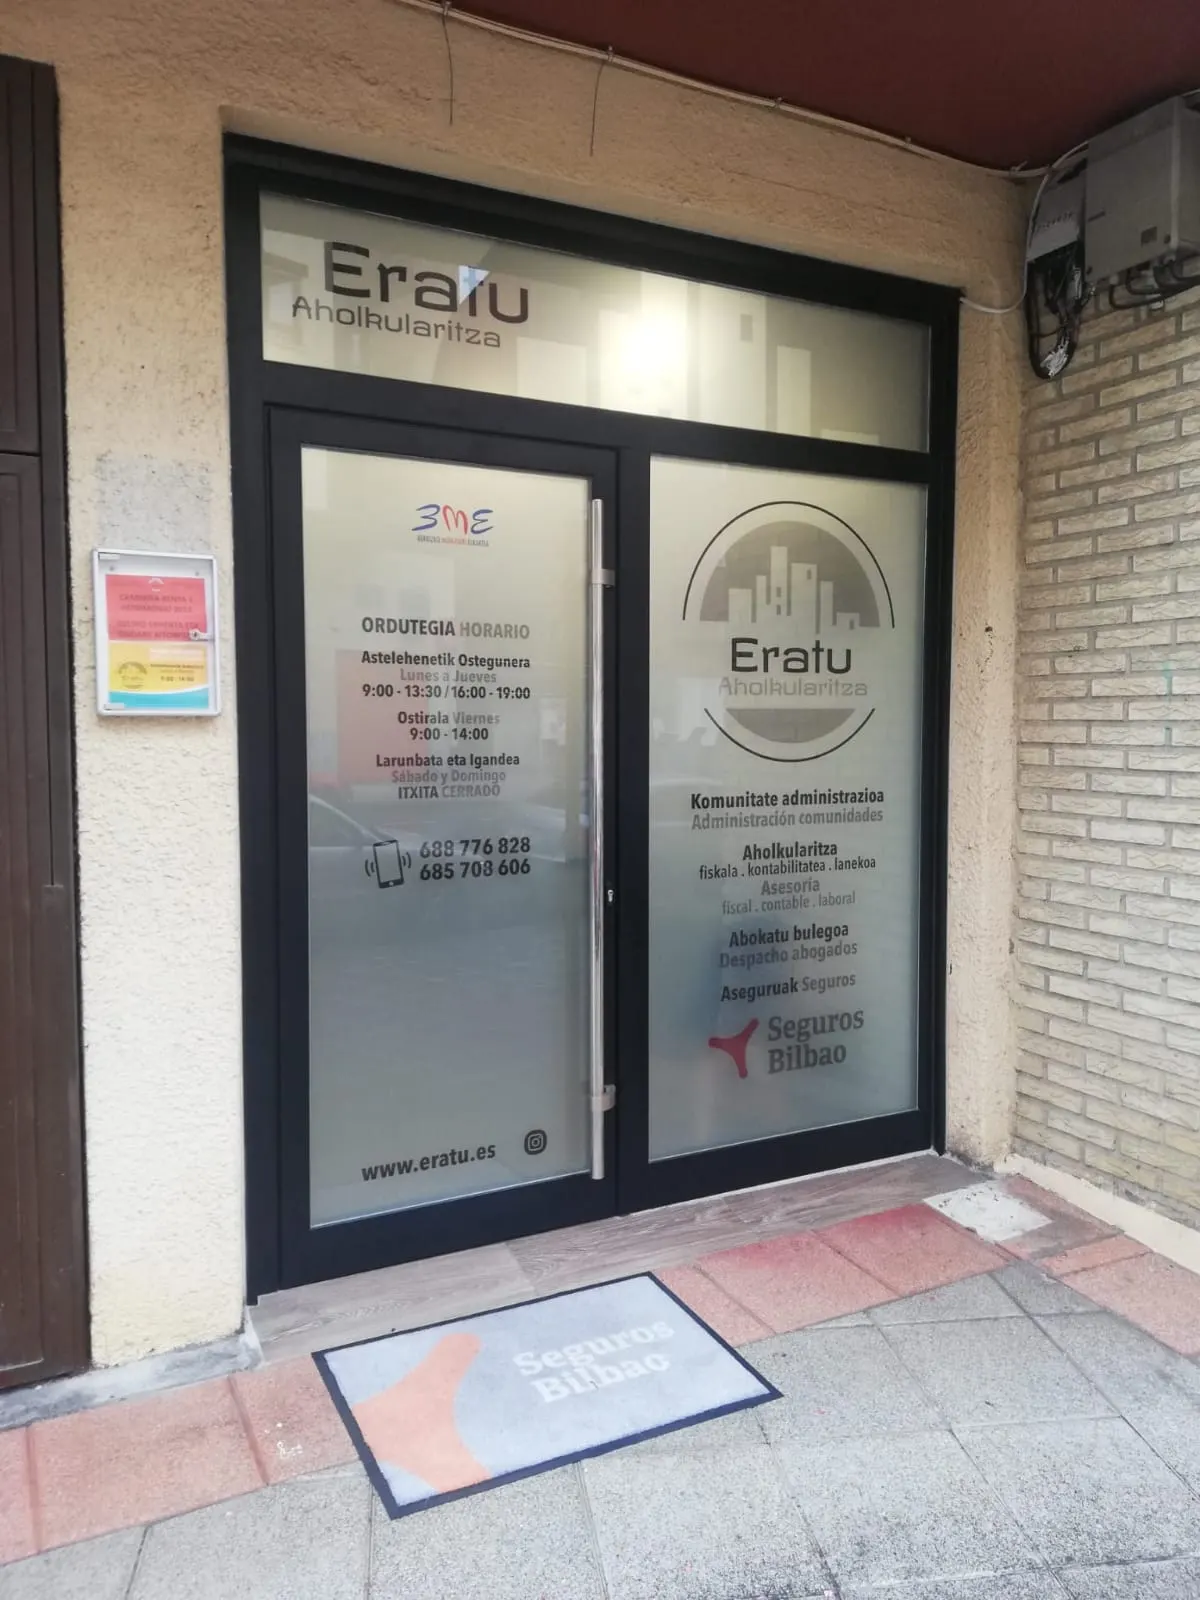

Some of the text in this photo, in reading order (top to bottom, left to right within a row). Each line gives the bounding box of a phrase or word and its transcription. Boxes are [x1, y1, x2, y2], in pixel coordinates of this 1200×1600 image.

[324, 241, 528, 324] Eratu
[292, 295, 501, 348] Aholkularitza
[361, 616, 530, 639] ORDUTEGIA HORARIO
[361, 650, 531, 671] Astelehenetik Ostegunera
[731, 637, 852, 674] Eratu
[400, 668, 498, 684] Lunes a Jueves
[718, 677, 868, 697] Aholkularitza
[362, 684, 394, 698] 9:00
[406, 685, 442, 698] 13:30
[452, 686, 487, 700] 16:00
[497, 686, 531, 700] 19:00
[397, 711, 501, 725] Ostirala Viernes
[410, 727, 441, 741] 9:00
[452, 728, 489, 741] 14:00
[376, 753, 521, 769] Larunbata eta Igandea
[391, 769, 507, 786] Sábado y Domingo
[398, 784, 501, 800] ITXITA CERRADO
[691, 788, 885, 810] Komunitate administrazioa
[691, 807, 884, 831] Administración comunidades
[419, 836, 531, 859] 688 776 828
[742, 840, 838, 861] Aholkularitza
[419, 858, 531, 881] 685 708 606
[699, 864, 738, 881] fiskala
[747, 860, 826, 877] kontabilitatea
[834, 856, 876, 871] lanekoa
[722, 901, 752, 915] fiscal
[761, 896, 810, 912] contable
[818, 891, 856, 907] laboral
[728, 923, 849, 948] Abokatu bulegoa
[718, 941, 858, 970] Despacho abogados
[720, 974, 856, 1003] Aseguruak Seguros
[767, 1010, 865, 1043] Seguros
[767, 1044, 847, 1075] Bilbao
[361, 1144, 497, 1182] www.eratu.es
[512, 1320, 676, 1376] Seguros
[528, 1353, 671, 1404] Bilbao
